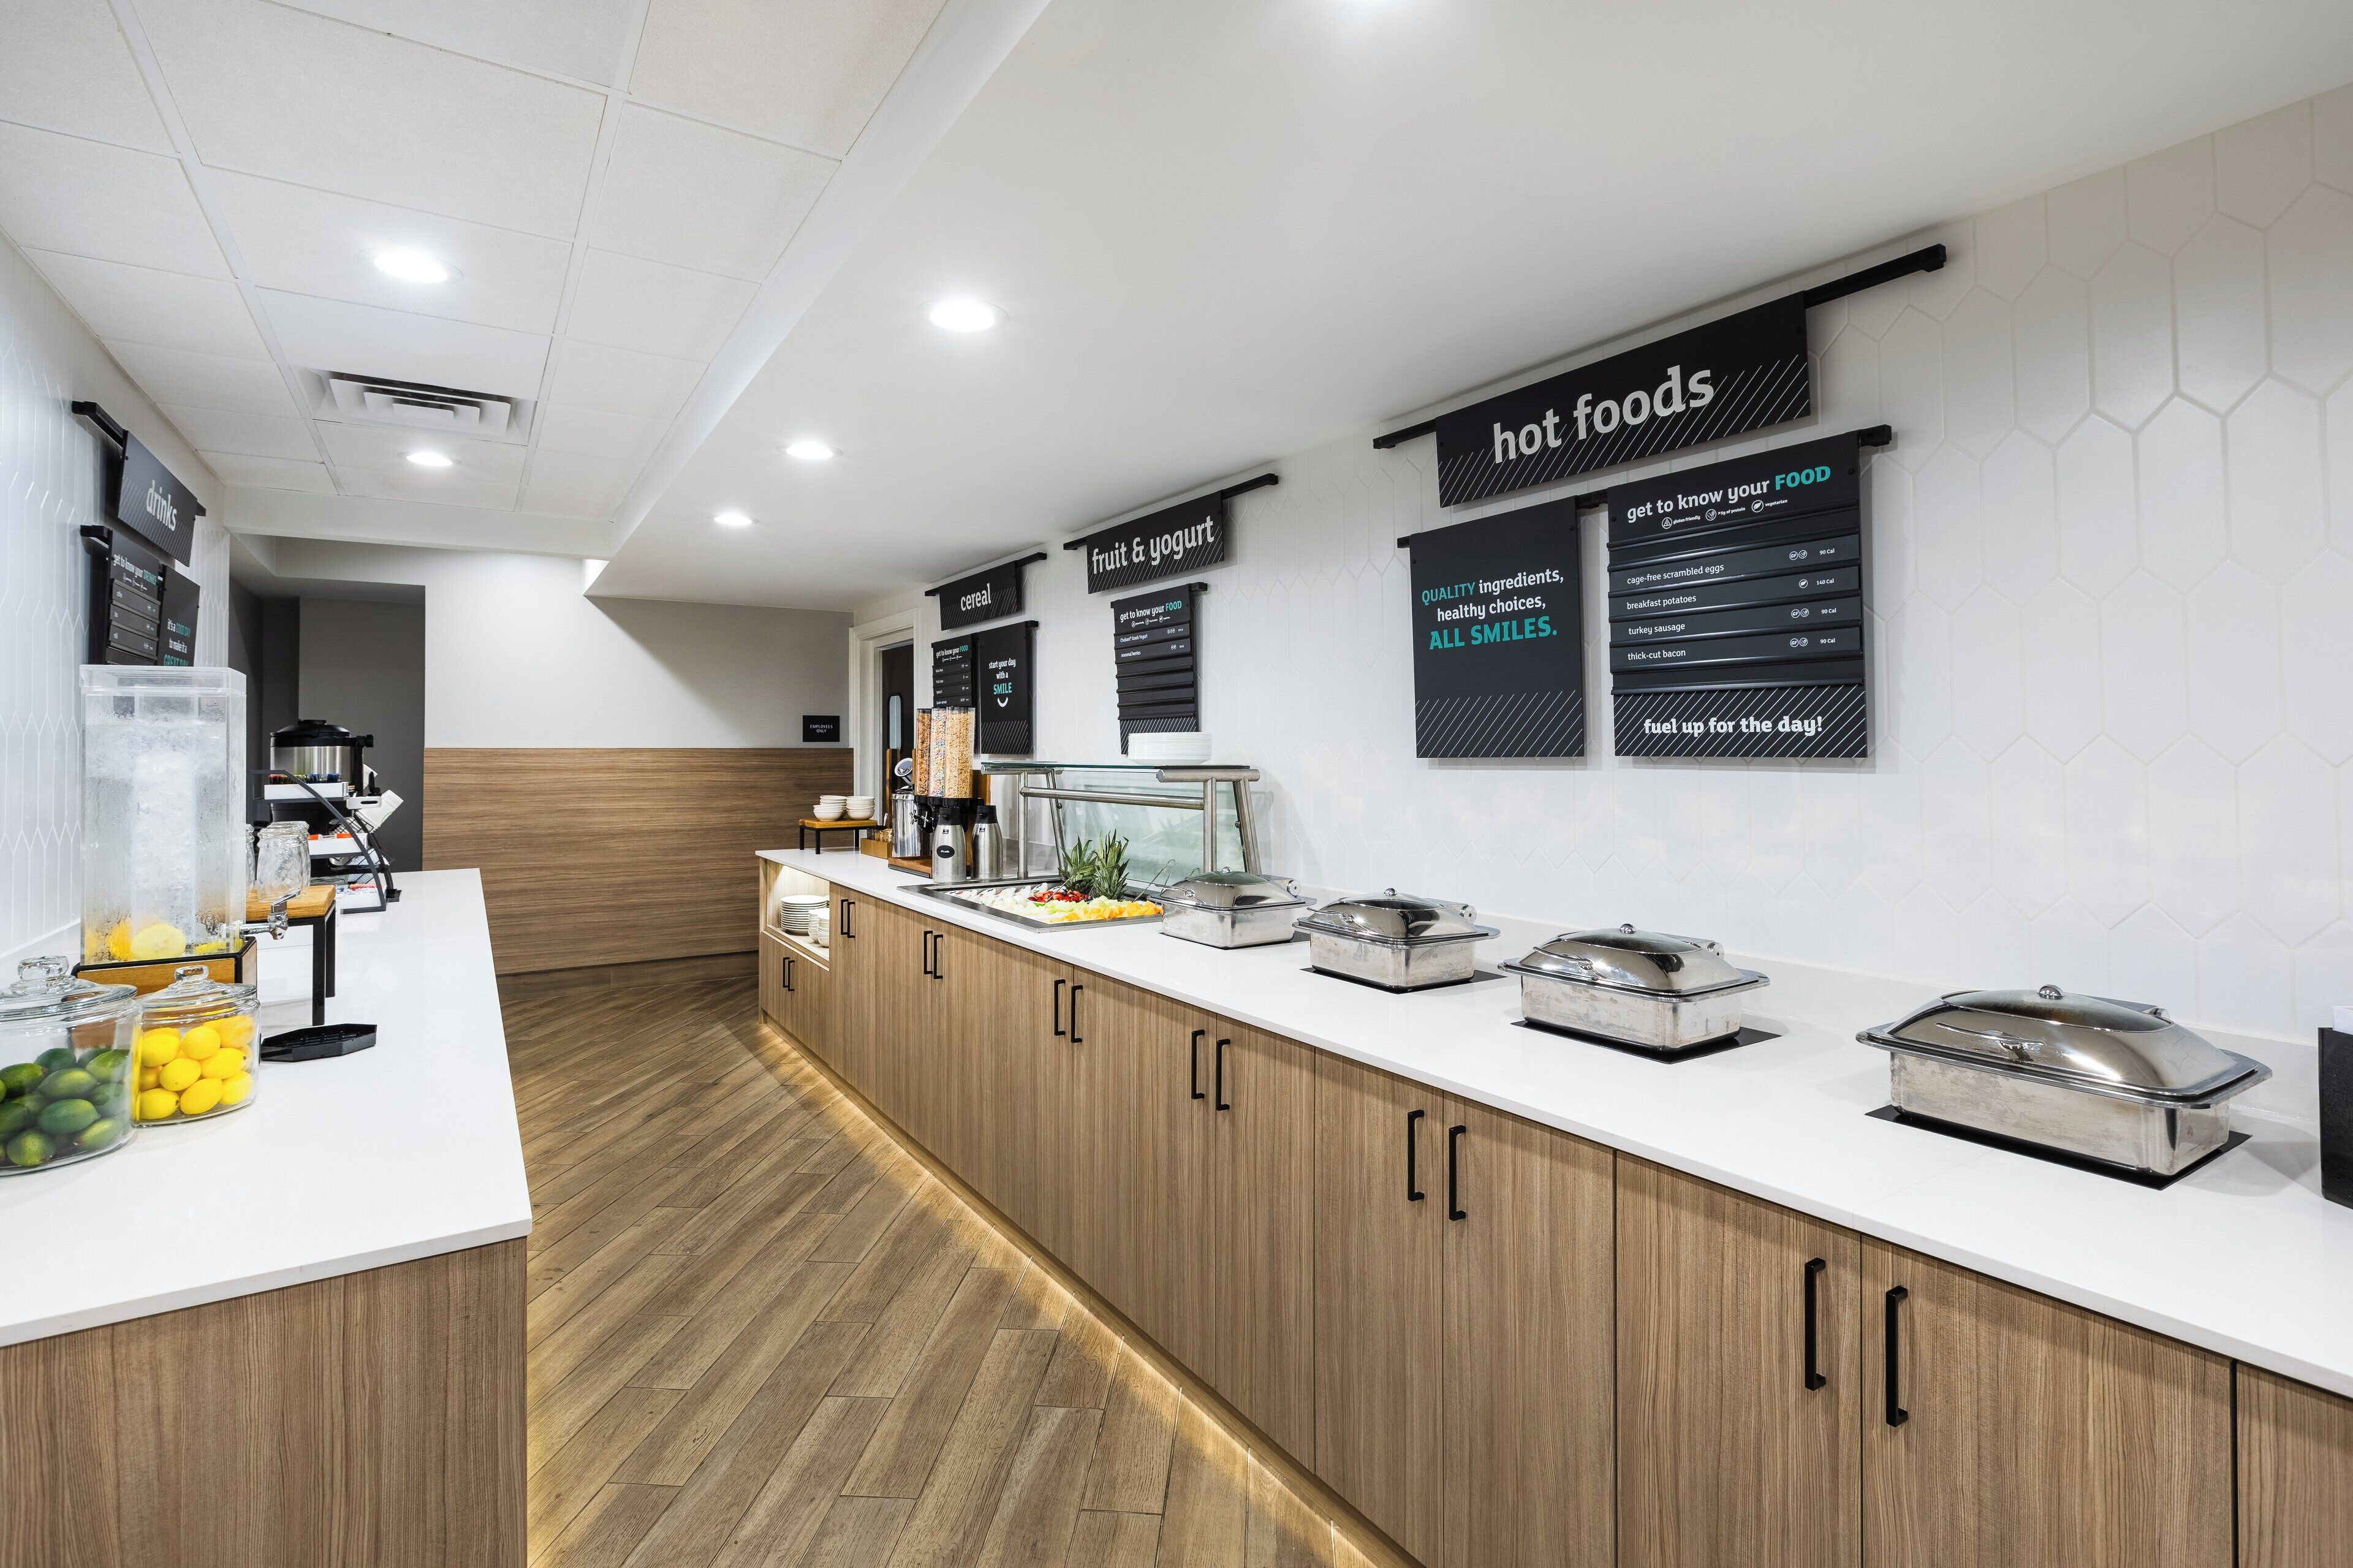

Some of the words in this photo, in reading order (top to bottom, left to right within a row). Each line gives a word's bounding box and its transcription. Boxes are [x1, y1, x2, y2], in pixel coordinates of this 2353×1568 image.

[1493, 408, 1562, 464] hot
[1573, 365, 1715, 441] foods
[146, 479, 177, 531] drinks
[1627, 502, 1653, 523] get
[1656, 499, 1673, 513] to
[1678, 490, 1723, 510] know
[1727, 480, 1770, 504] your
[1775, 466, 1831, 490] FOOD
[1093, 542, 1127, 574] fruit
[1132, 537, 1145, 563] &
[1150, 515, 1214, 566] yogurt
[1627, 574, 1661, 585] cage-free
[1663, 566, 1703, 579] scrambled
[1705, 564, 1724, 575] eggs
[961, 583, 991, 611] cereal
[1422, 582, 1476, 605] QUALITY
[1479, 569, 1564, 595] ingredients,
[1120, 612, 1129, 623] get
[1136, 608, 1151, 618] know
[1151, 605, 1164, 616] your
[1165, 600, 1182, 611] FOOD
[1437, 604, 1485, 621] healthy
[1489, 596, 1546, 614] choices,
[1627, 599, 1661, 610] breakfast
[1662, 596, 1697, 607] potatoes
[1430, 628, 1465, 650] ALL
[1471, 616, 1557, 645] SMILES.
[1628, 626, 1653, 635] turkey
[1654, 623, 1686, 632] sausage
[988, 661, 998, 669] start
[998, 661, 1008, 670] your
[1007, 657, 1016, 667] day
[1627, 651, 1661, 661] thick-cut
[1662, 650, 1686, 658] bacon
[996, 670, 1005, 680] with
[993, 682, 1012, 695] SMILE
[1643, 719, 1677, 734] fuel
[1682, 721, 1704, 737] up
[1708, 718, 1735, 733] for
[1740, 716, 1773, 732] the
[1778, 716, 1823, 736] day!
